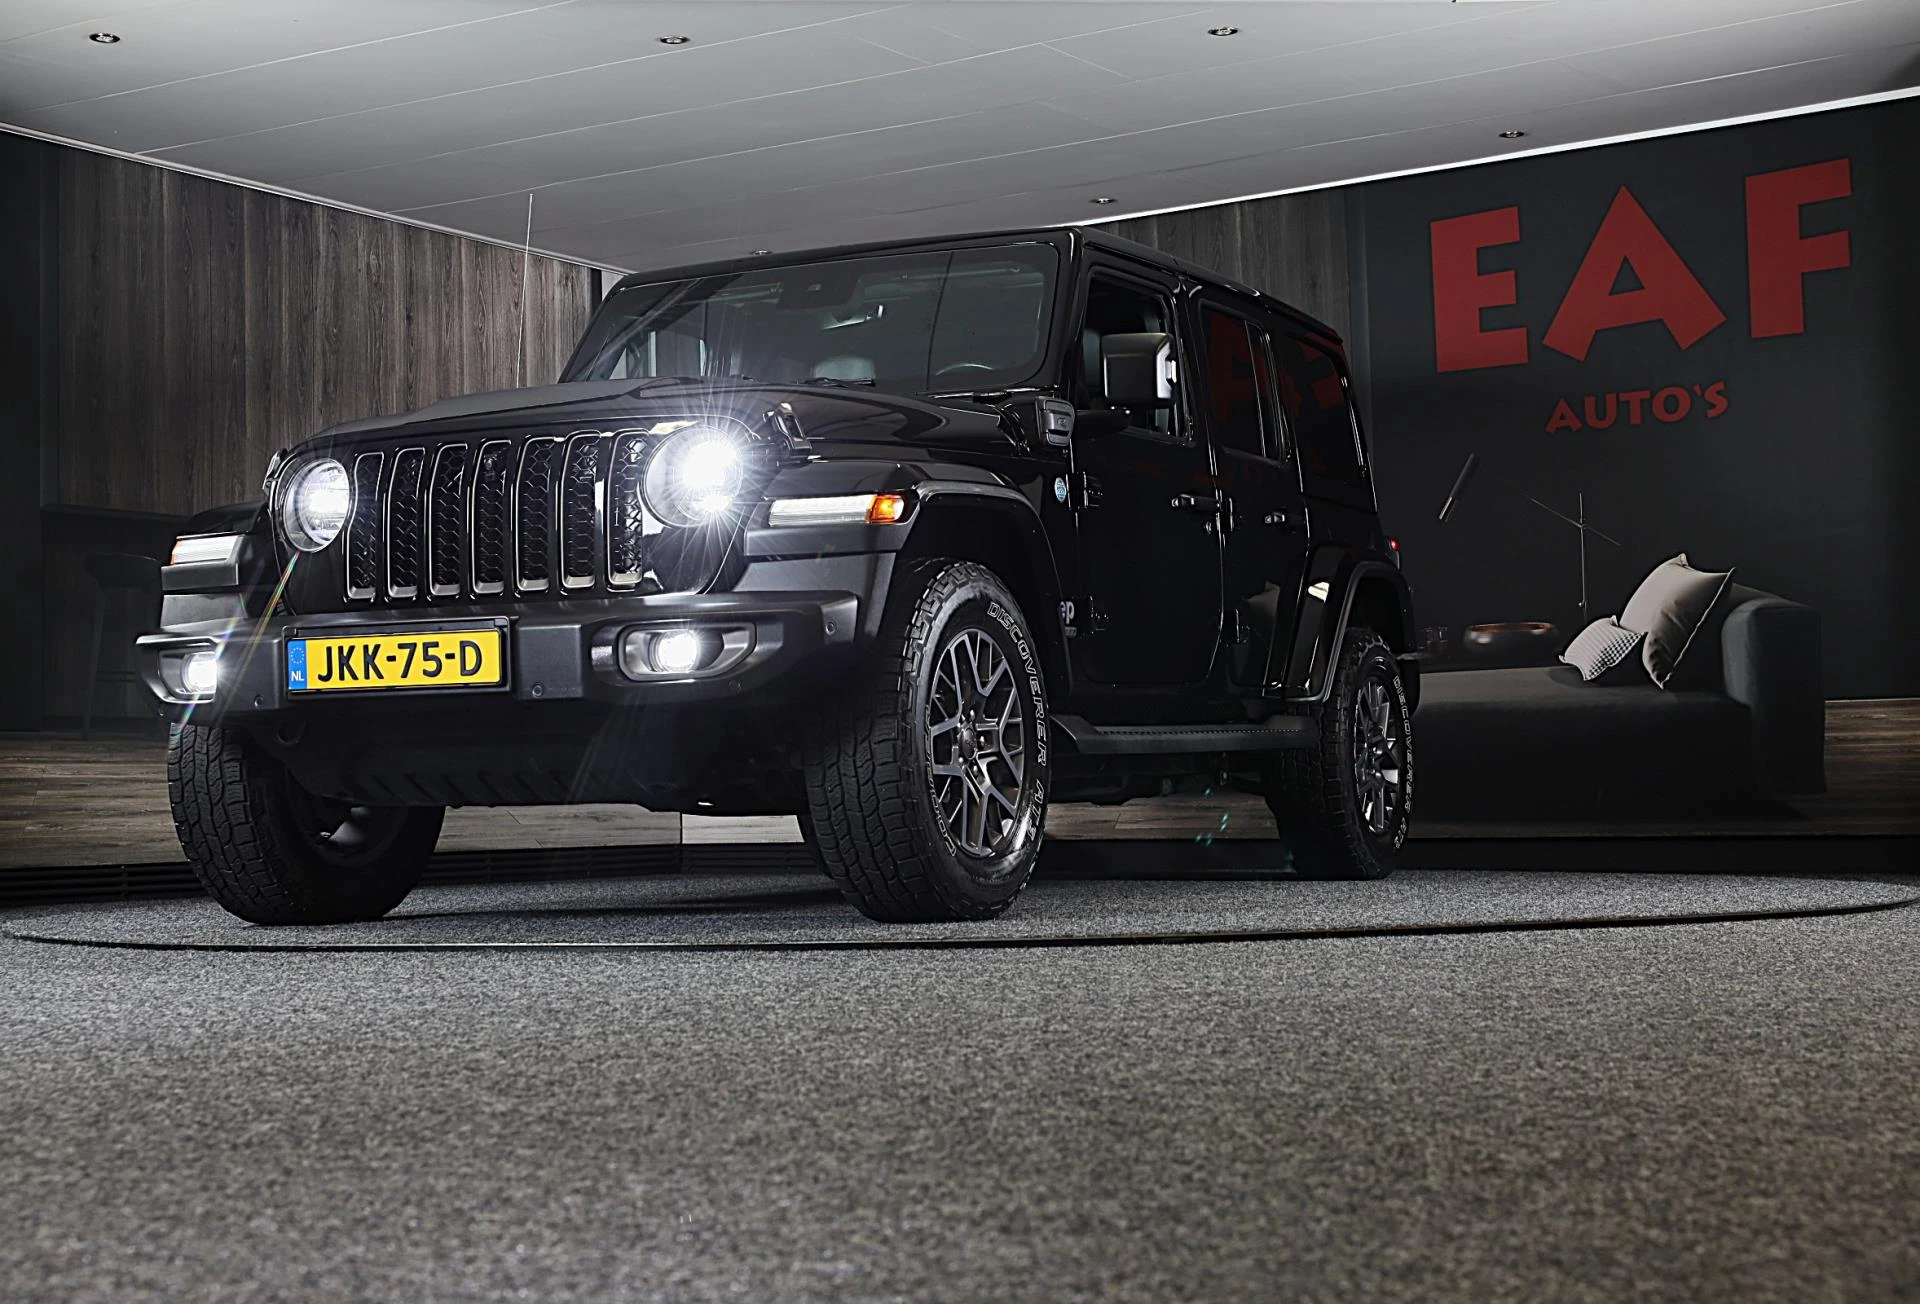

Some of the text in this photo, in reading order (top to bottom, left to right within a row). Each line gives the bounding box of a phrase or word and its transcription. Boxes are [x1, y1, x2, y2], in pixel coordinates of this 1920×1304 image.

[1429, 158, 1852, 373] EAF
[1545, 381, 1729, 433] AUTO'S
[291, 670, 305, 682] NL
[317, 640, 483, 683] JKK-75-D
[987, 600, 1048, 767] DISCOVERER
